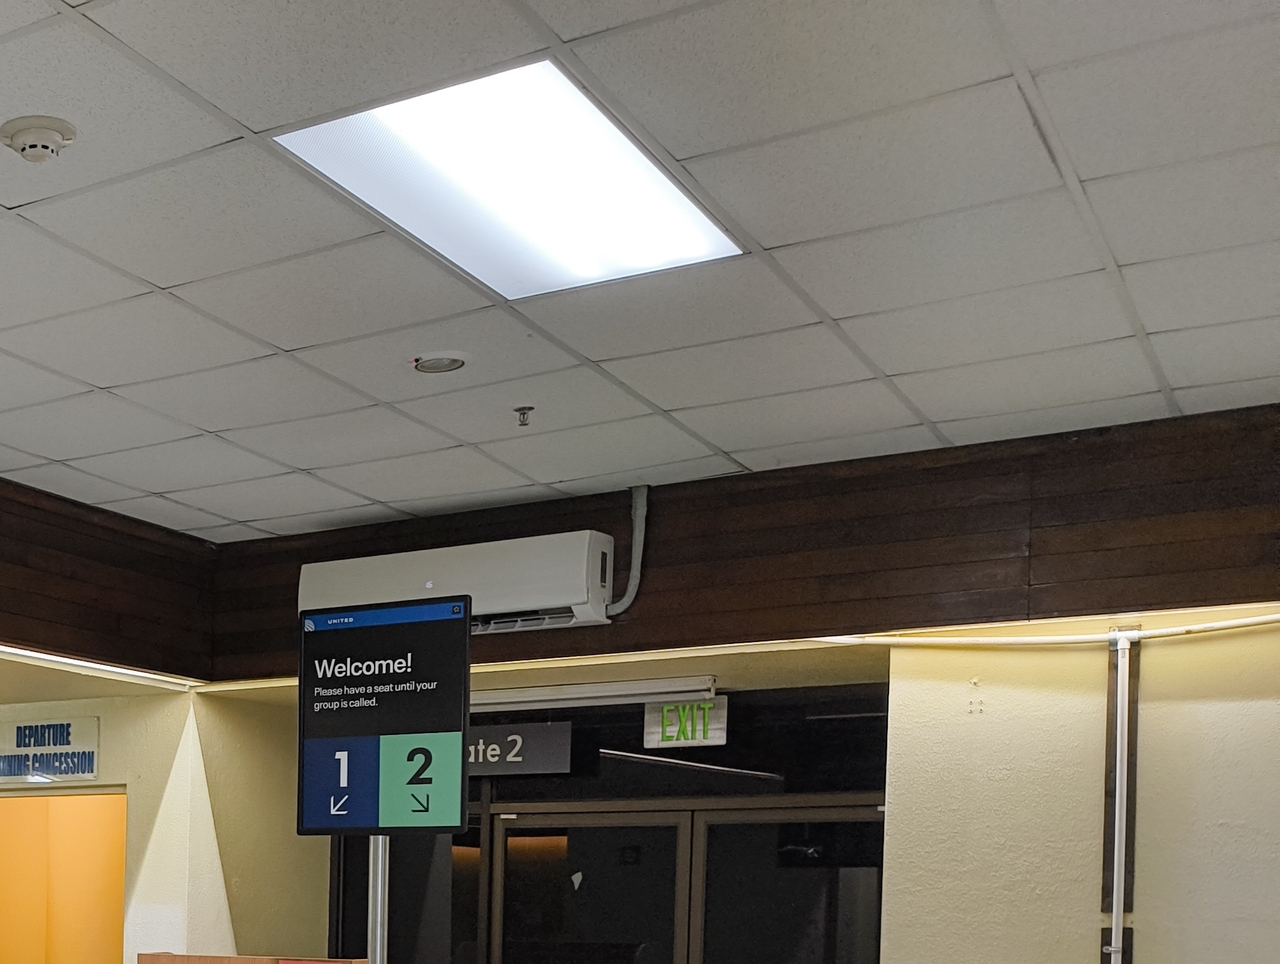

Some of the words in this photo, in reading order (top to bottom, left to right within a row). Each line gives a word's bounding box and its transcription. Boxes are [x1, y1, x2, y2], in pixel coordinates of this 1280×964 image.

[327, 617, 354, 625] UNITED
[314, 652, 412, 679] Welcome!
[314, 686, 343, 697] Please
[343, 685, 366, 695] have
[373, 684, 393, 693] seat
[394, 681, 415, 692] until
[415, 680, 438, 693] your
[313, 700, 340, 712] group
[340, 699, 348, 708] is
[348, 697, 379, 708] called.
[16, 723, 71, 748] DEPARTURE
[661, 703, 714, 742] EXIT
[468, 738, 501, 763] te
[506, 734, 523, 762] 2
[31, 751, 95, 776] CONCESSION
[334, 751, 349, 788] 1
[405, 747, 433, 785] 2
